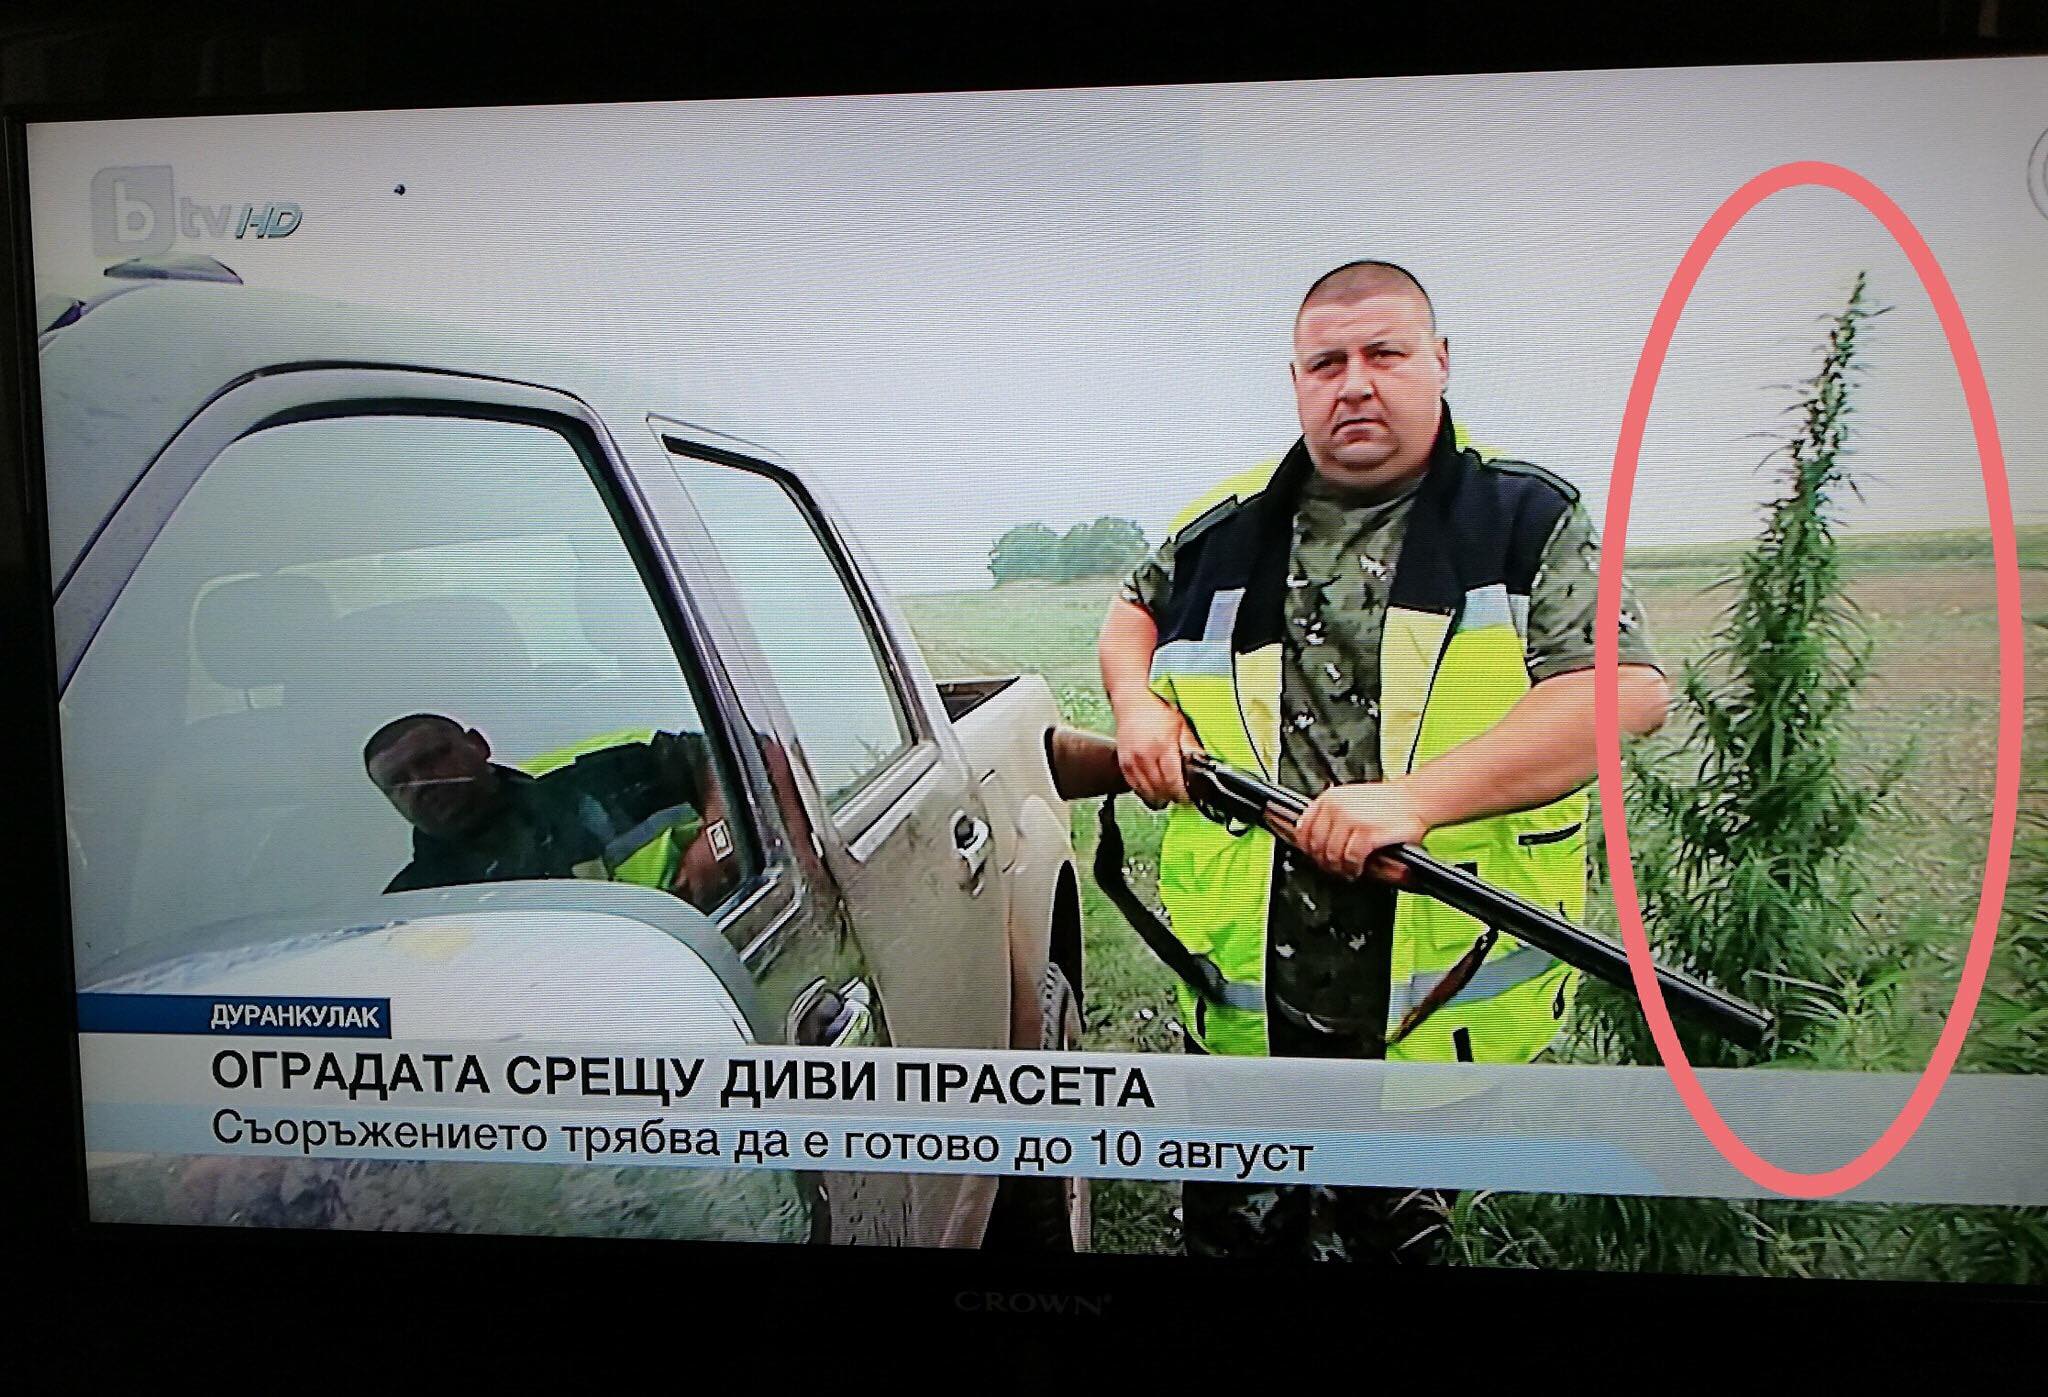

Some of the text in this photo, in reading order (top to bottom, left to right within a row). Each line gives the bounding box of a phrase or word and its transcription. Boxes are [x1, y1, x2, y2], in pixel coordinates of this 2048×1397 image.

[234, 202, 304, 239] HD
[210, 1002, 381, 1030] ДУРАНКУЛАК
[212, 1049, 1157, 1109] ОГРАДАТА СРЕЩУ ДИВИ ПРАСЕТА
[212, 1109, 1315, 1179] Съоръжението трябва да е готово до 10 август
[953, 1289, 1101, 1317] CROWN
